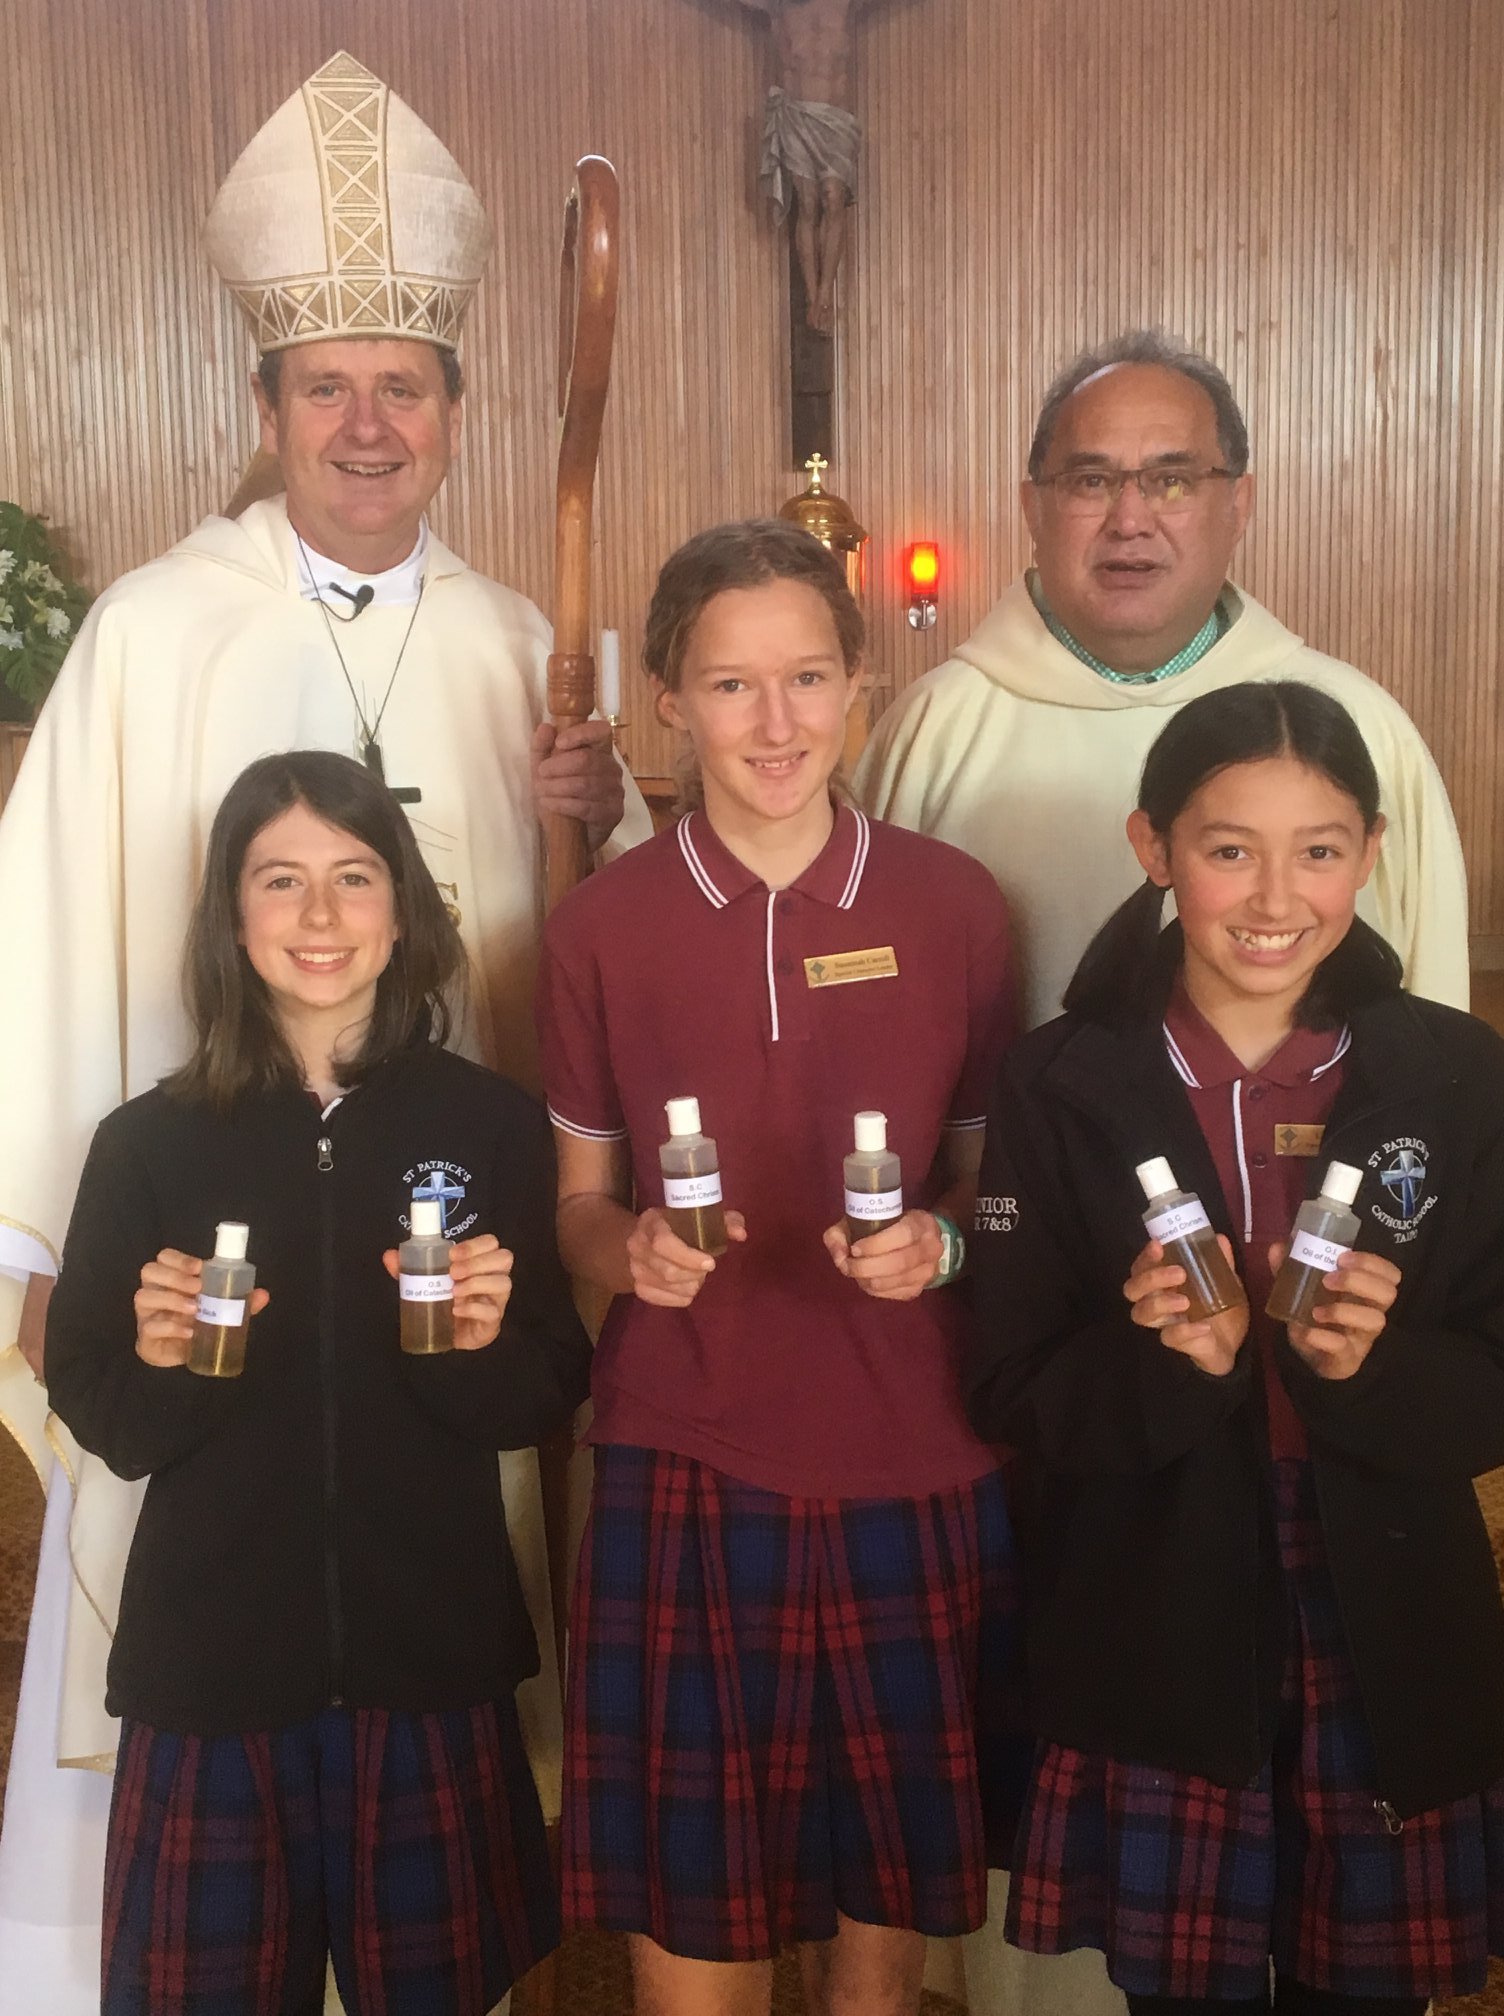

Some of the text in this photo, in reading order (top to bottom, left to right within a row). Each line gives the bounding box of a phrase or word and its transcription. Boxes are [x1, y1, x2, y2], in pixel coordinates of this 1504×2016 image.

[1367, 1150, 1382, 1168] ST
[402, 1160, 473, 1184] ST PATRICK'S
[444, 1212, 478, 1240] SCHOOL
[1371, 1204, 1413, 1230] CATHOLIC
[1302, 1247, 1336, 1266] Oil of the
